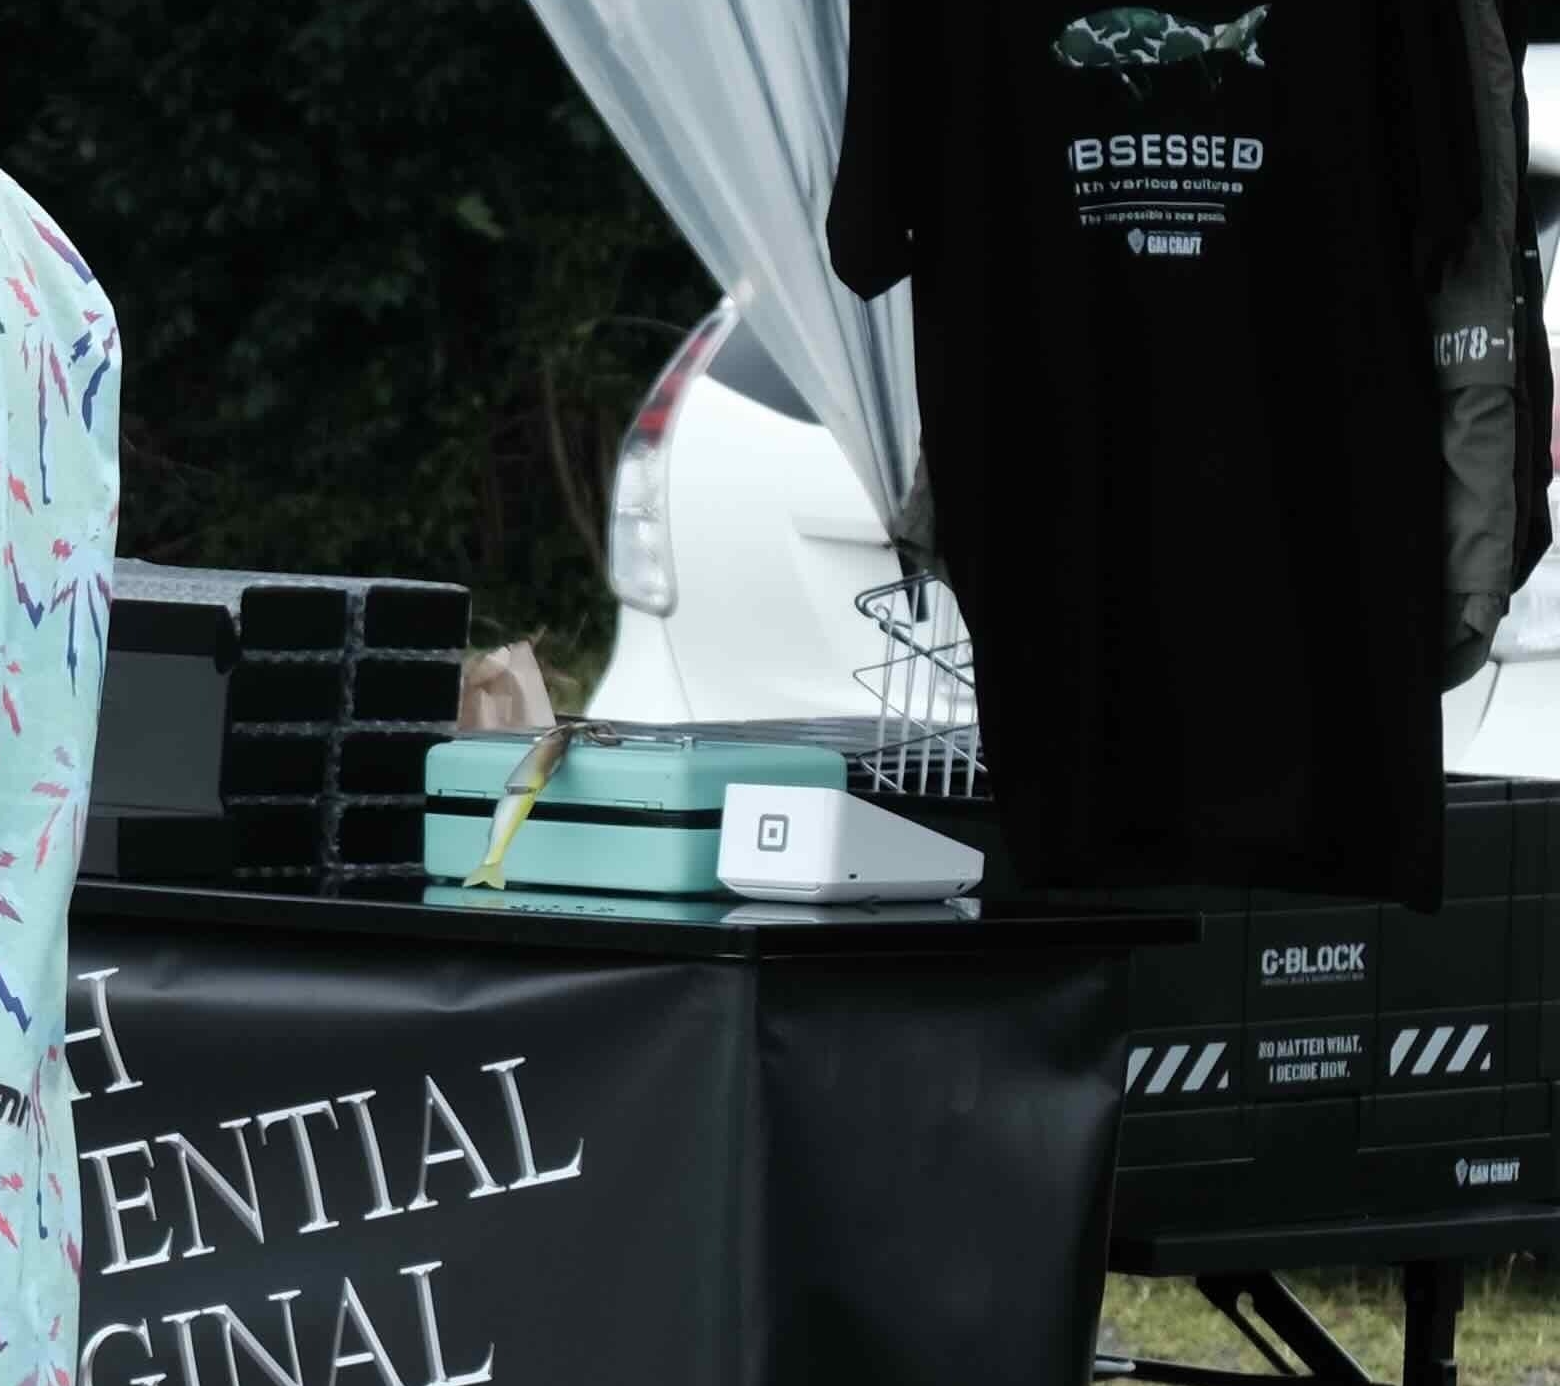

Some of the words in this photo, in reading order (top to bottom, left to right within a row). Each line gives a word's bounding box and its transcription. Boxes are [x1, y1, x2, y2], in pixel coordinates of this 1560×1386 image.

[1069, 133, 1264, 172] BSESSED
[1109, 177, 1179, 191] various
[1147, 235, 1169, 255] GAN
[1169, 235, 1202, 255] CRAFT
[1258, 1041, 1275, 1059] NO
[1276, 1037, 1326, 1058] MATTER
[1276, 1062, 1319, 1083] DECIDE
[78, 1055, 584, 1275] ENTIAL
